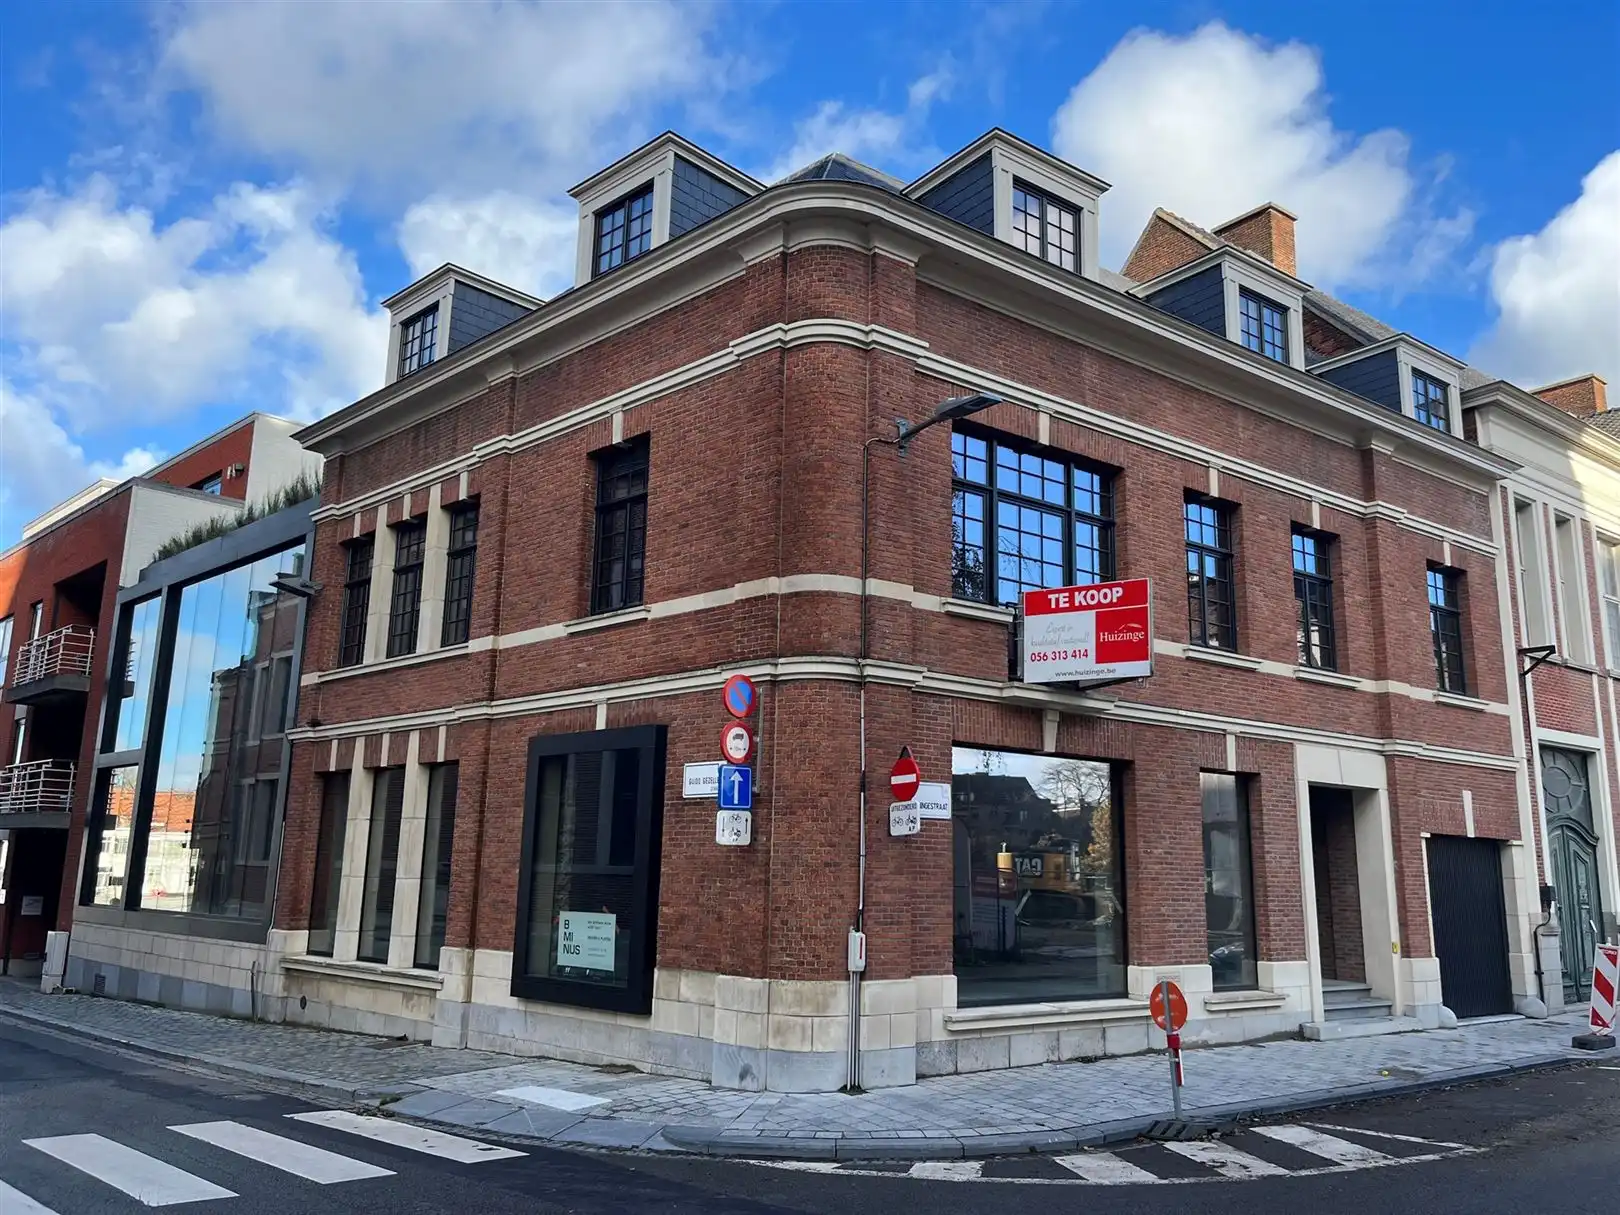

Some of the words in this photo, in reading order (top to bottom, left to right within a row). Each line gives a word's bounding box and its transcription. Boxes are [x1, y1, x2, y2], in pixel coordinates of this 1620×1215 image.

[1048, 592, 1069, 608] TE
[1074, 587, 1123, 606] KOOP
[1100, 630, 1144, 642] Huizinge
[1030, 651, 1049, 662] 056
[1051, 650, 1068, 661] 313
[1071, 648, 1089, 660] 414
[1055, 668, 1116, 677] www.huizinge.be
[702, 776, 719, 785] GEZELL
[920, 802, 948, 810] INGESTRAAT
[564, 919, 570, 929] B
[563, 931, 574, 942] MI
[562, 943, 581, 955] NUS
